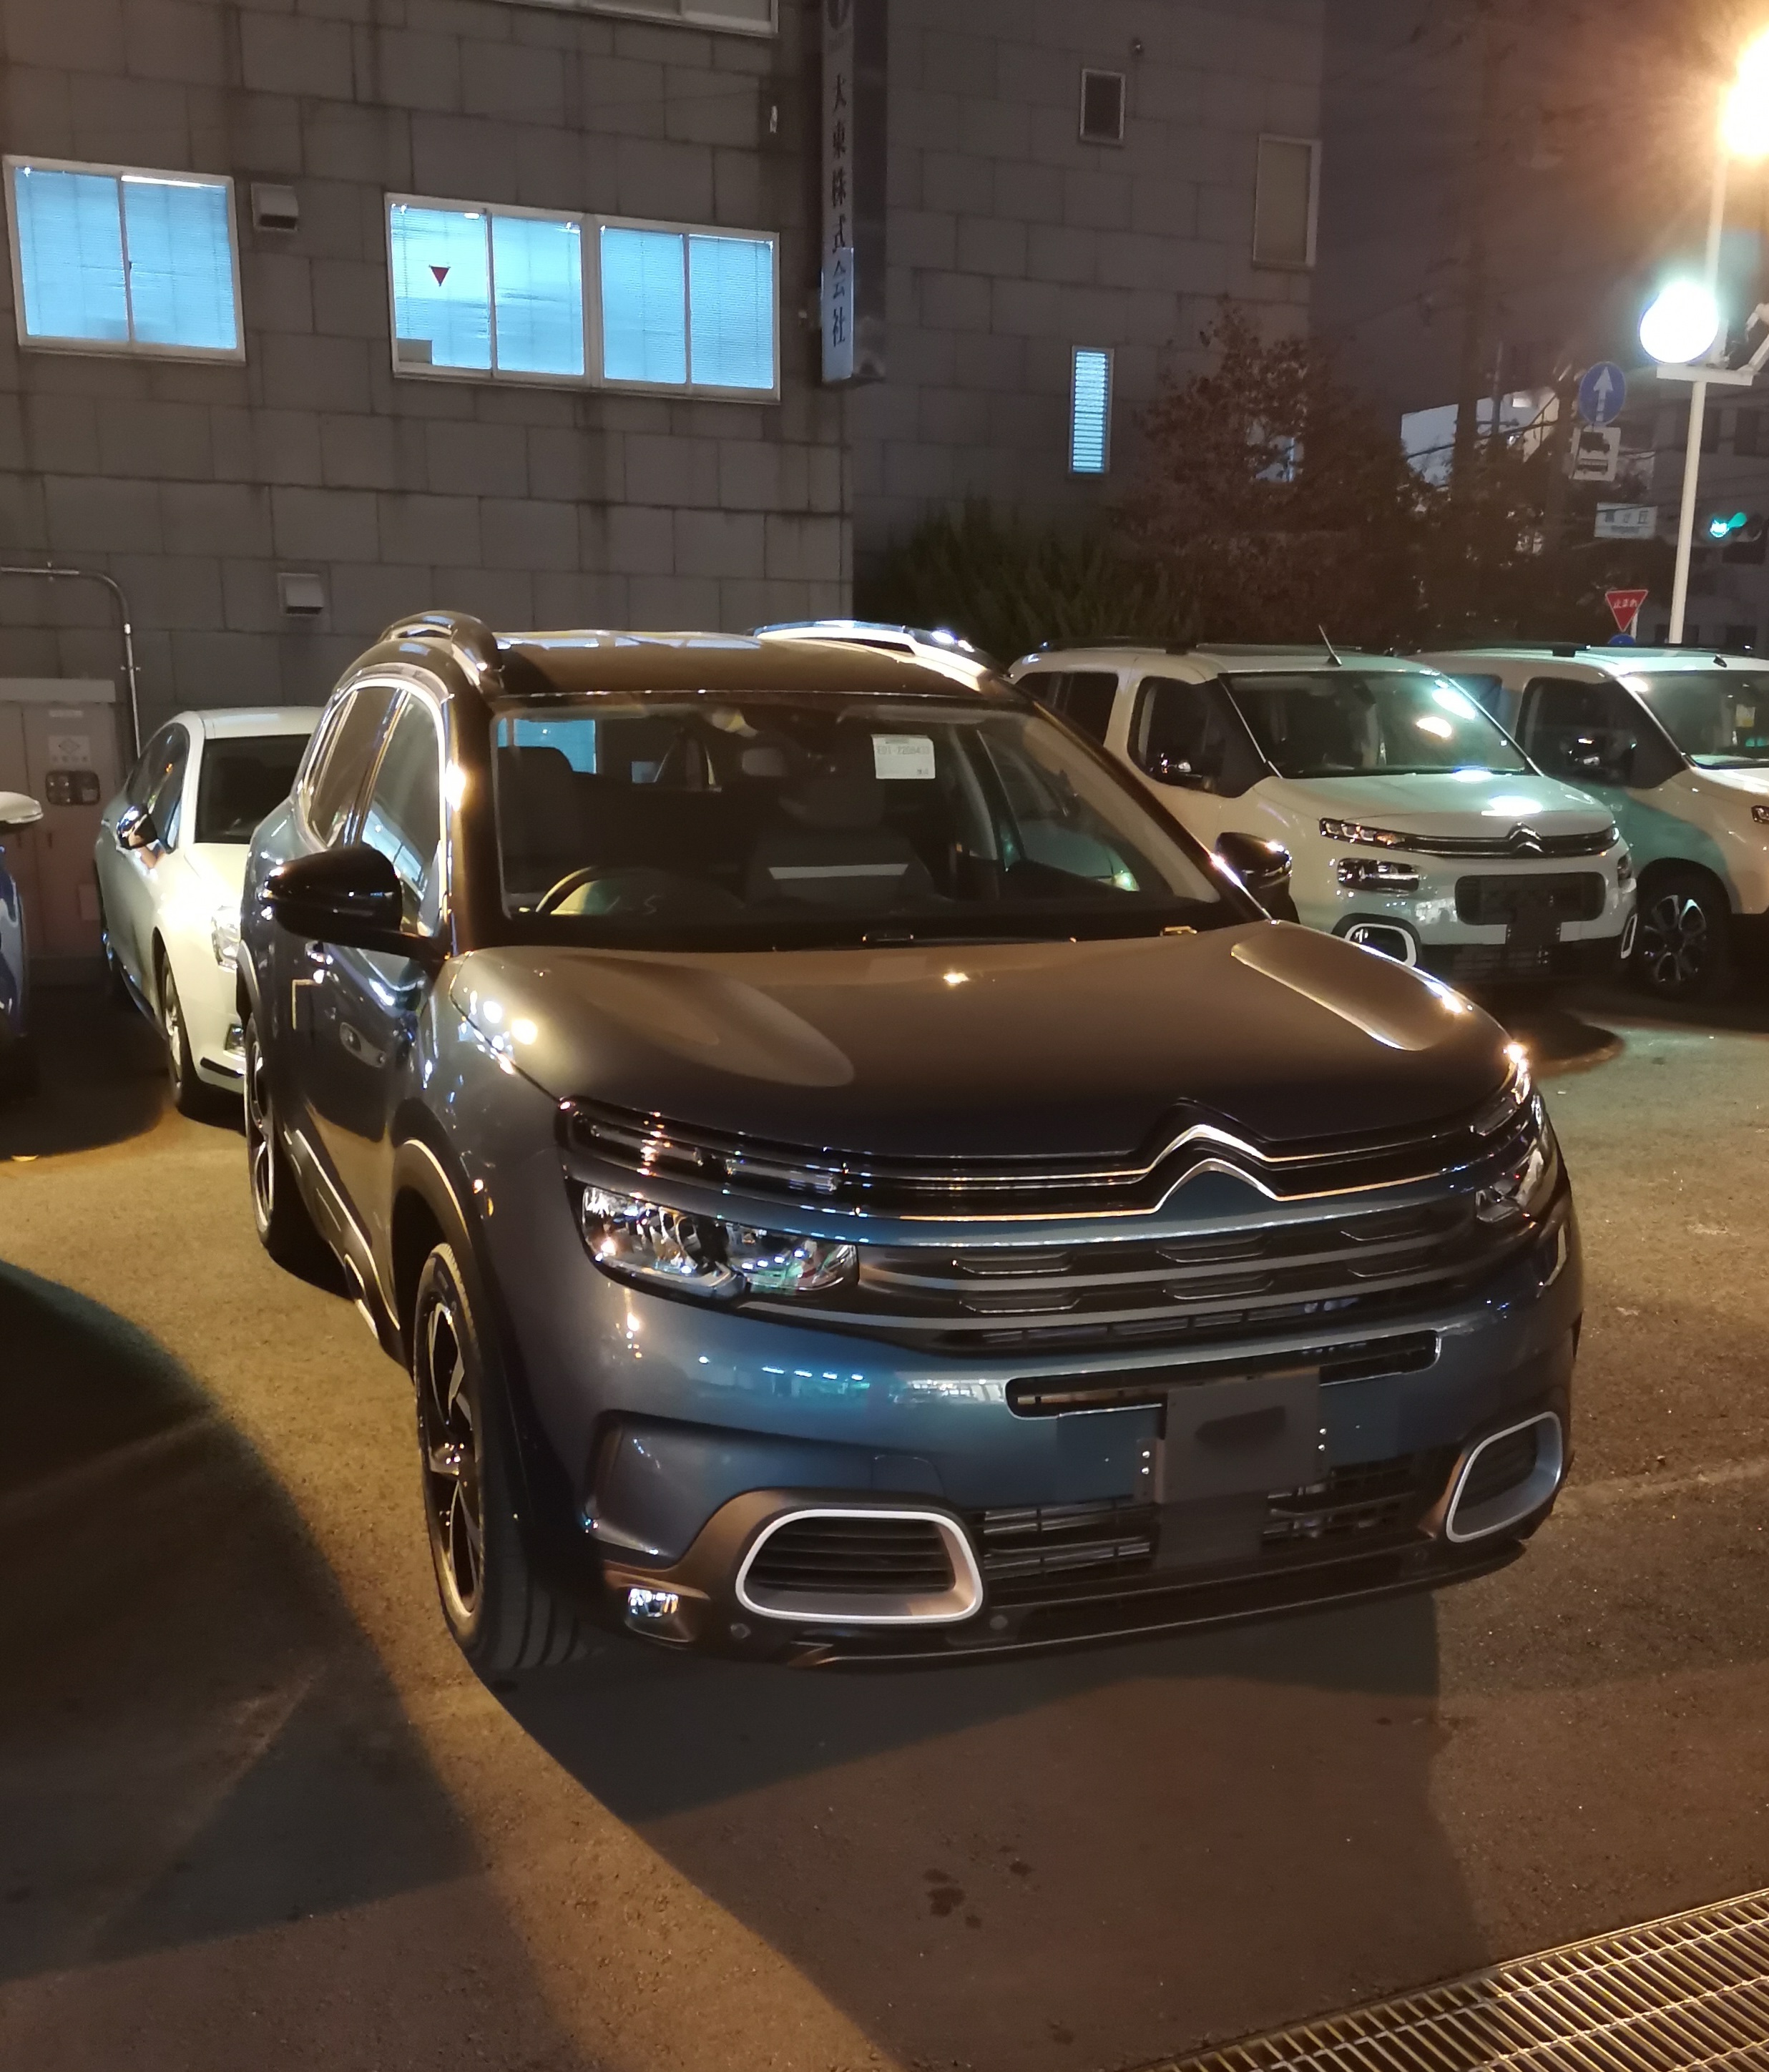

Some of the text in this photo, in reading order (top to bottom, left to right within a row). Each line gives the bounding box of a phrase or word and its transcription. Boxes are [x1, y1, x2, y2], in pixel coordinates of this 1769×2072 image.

[831, 74, 848, 348] 大東株式会社
[1612, 598, 1638, 609] 止まれ
